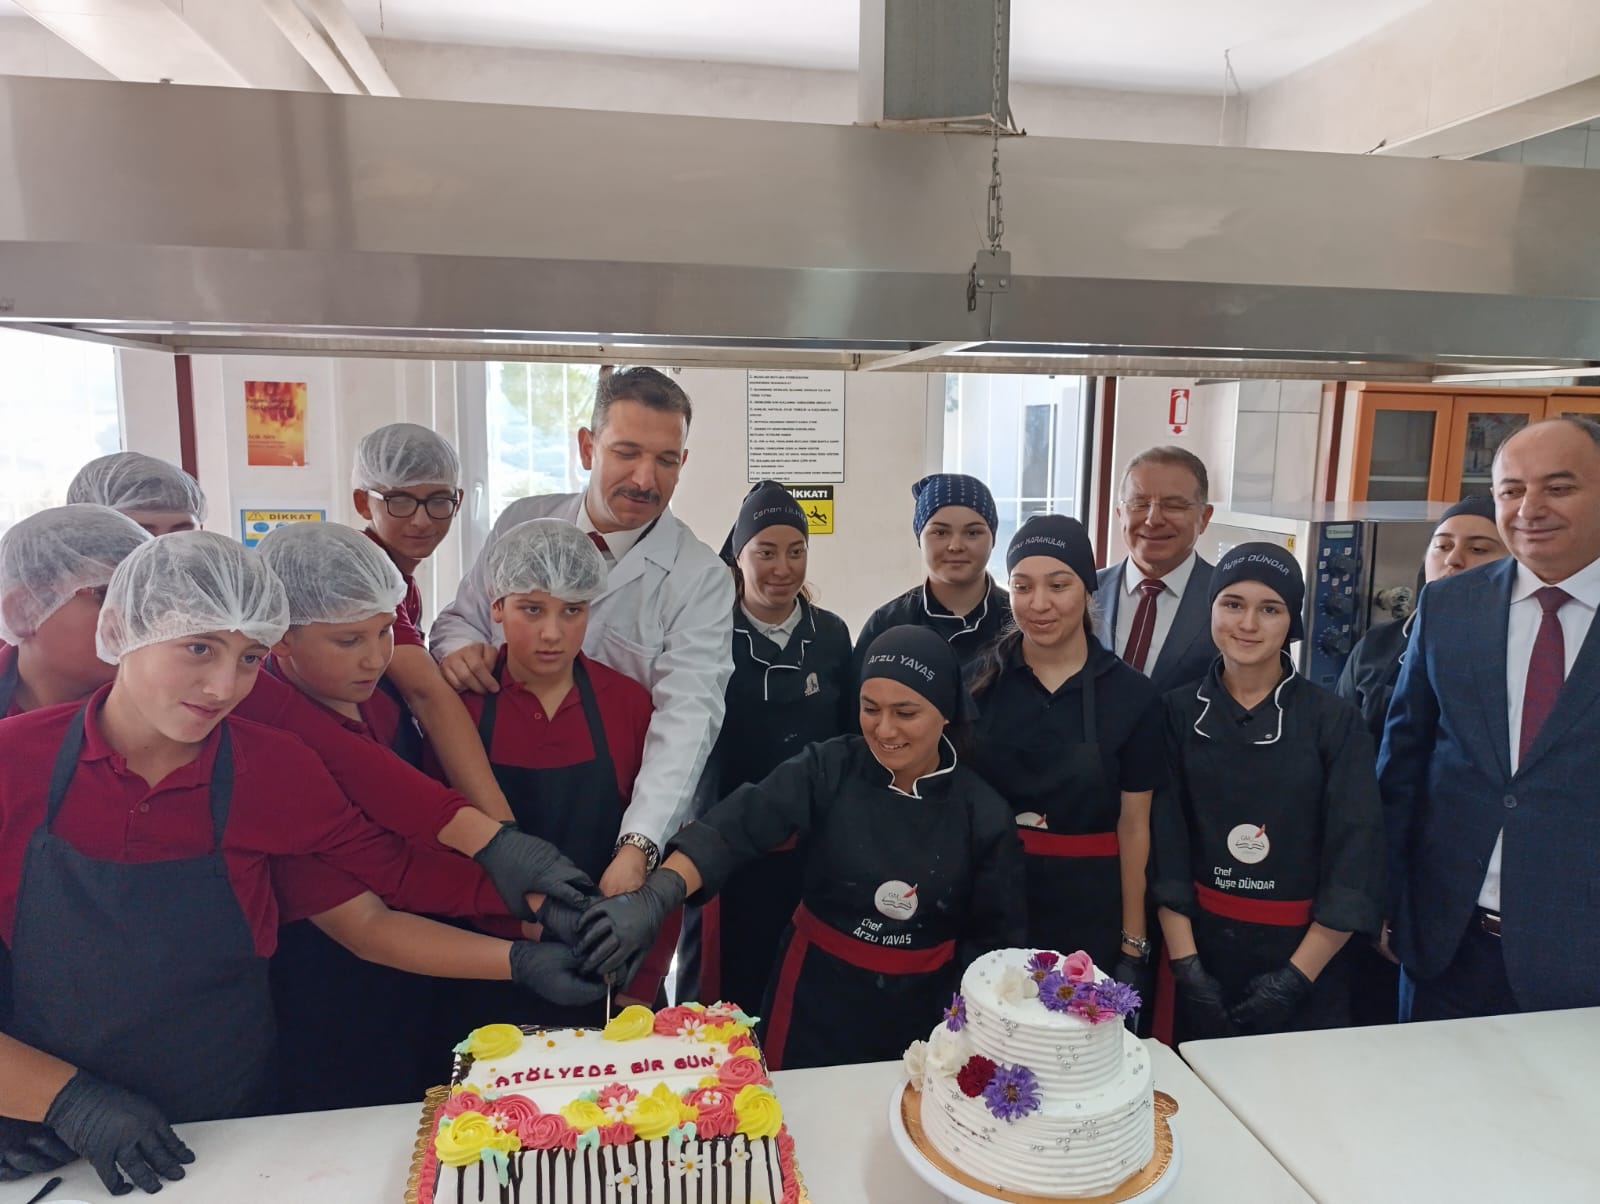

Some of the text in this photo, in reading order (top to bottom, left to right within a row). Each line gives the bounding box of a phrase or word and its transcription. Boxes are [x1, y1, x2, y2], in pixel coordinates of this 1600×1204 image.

[1247, 553, 1290, 576] DÜNDAR
[867, 654, 936, 682] Arzu YAVAŞ
[1213, 866, 1233, 876] Chef
[1238, 877, 1275, 890] DÜNDAR
[861, 918, 883, 932] Chef
[852, 926, 879, 943] Arzu
[495, 1055, 715, 1088] ATÖLYEDE BİR GÜN
